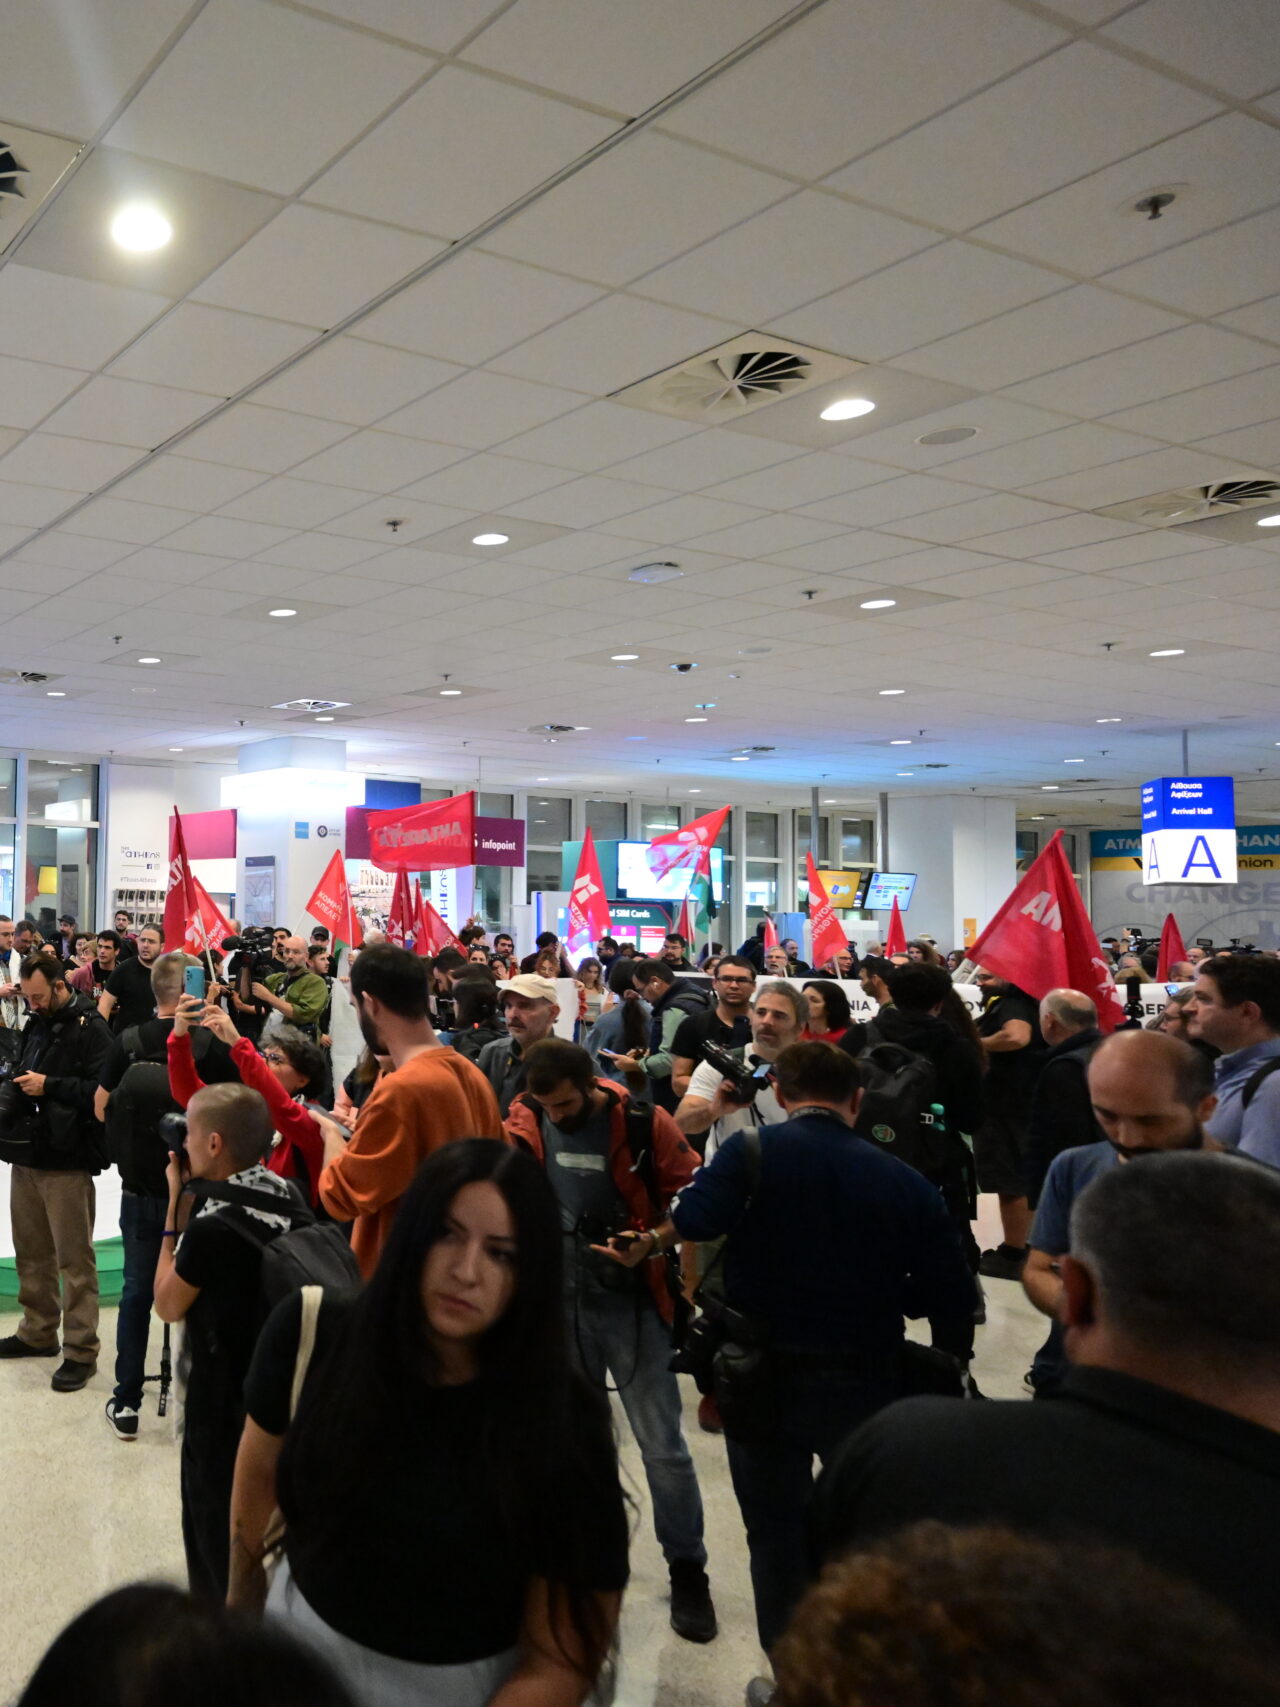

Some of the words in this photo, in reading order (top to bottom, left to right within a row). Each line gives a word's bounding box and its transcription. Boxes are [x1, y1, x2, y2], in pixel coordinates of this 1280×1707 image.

[1197, 807, 1213, 815] Hall
[482, 838, 516, 852] infopoint
[1104, 838, 1142, 850] ATM
[1237, 834, 1280, 847] HAN
[1181, 835, 1222, 879] A
[1238, 857, 1274, 868] nion
[616, 909, 630, 917] SIM
[631, 909, 650, 918] Cards
